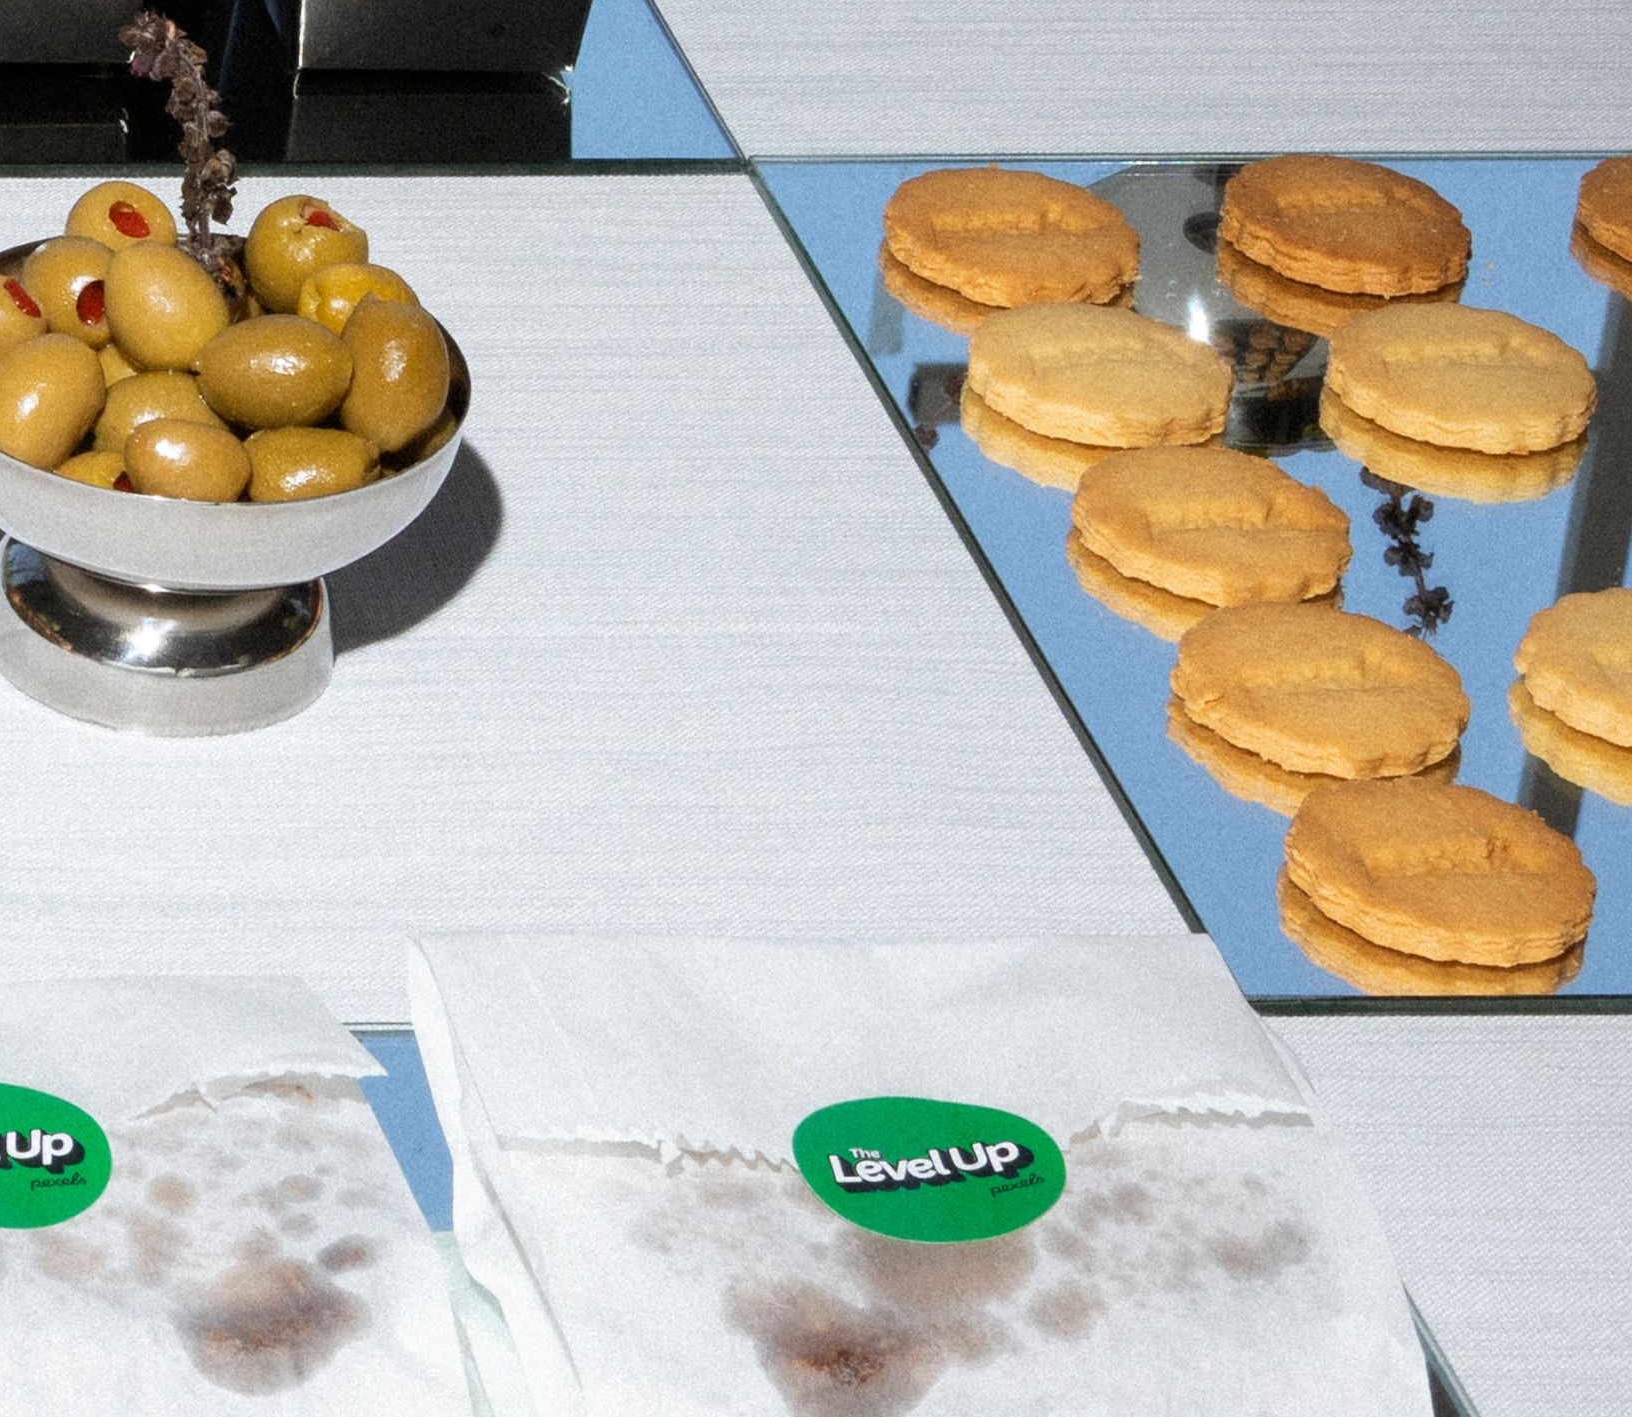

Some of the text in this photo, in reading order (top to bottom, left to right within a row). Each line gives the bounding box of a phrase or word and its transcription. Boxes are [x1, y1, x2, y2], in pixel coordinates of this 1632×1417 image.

[4, 1128, 77, 1168] Up
[848, 1147, 882, 1160] The
[827, 1140, 1023, 1186] Level Up
[30, 1171, 88, 1192] pexels
[989, 1172, 1046, 1199] pexels
